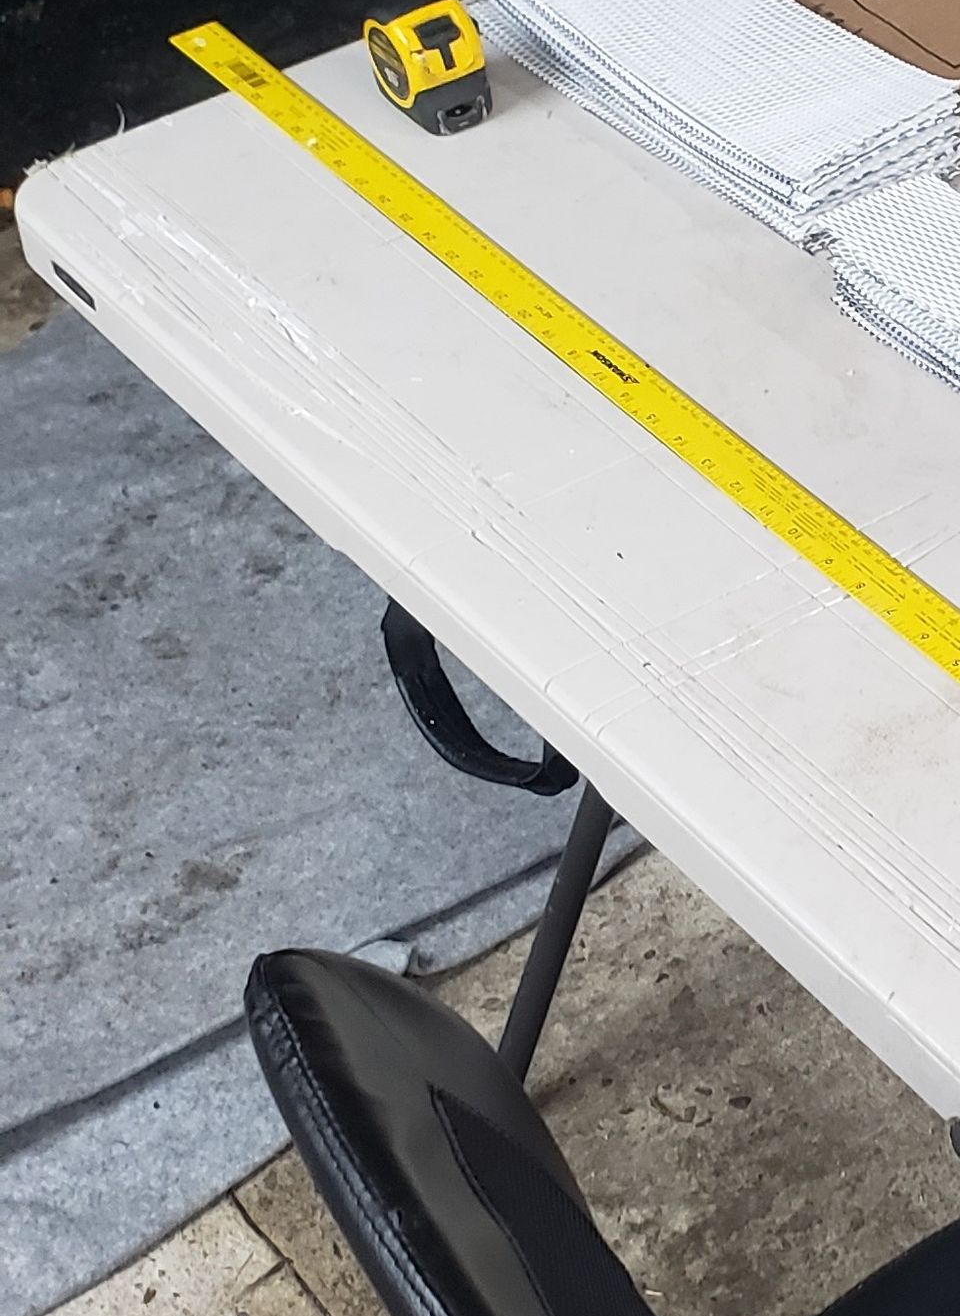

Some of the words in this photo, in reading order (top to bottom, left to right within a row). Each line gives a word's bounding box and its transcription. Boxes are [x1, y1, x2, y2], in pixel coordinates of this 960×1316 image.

[700, 458, 716, 470] 13
[729, 480, 744, 493] 12
[787, 527, 802, 540] 10
